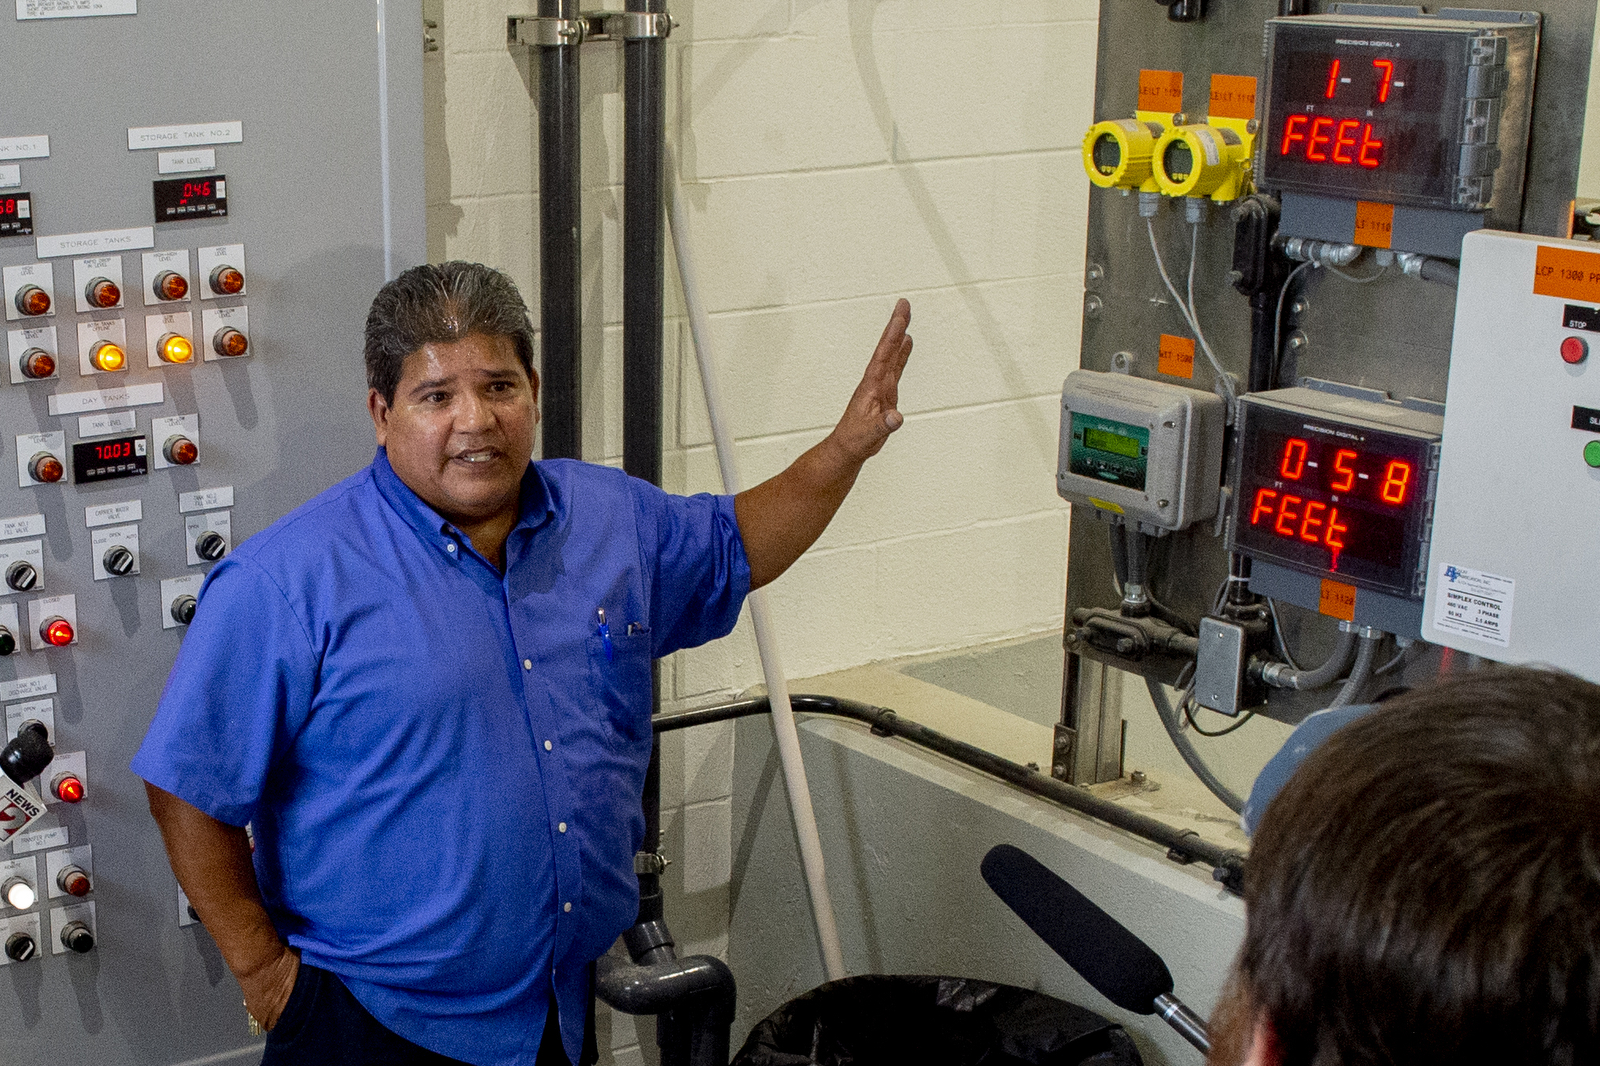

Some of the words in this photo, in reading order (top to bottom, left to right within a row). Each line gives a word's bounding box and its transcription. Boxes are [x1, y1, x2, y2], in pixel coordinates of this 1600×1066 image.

[1335, 39, 1368, 47] PRECISION
[1370, 40, 1394, 48] DIGITAL
[1306, 104, 1314, 112] FT
[140, 132, 178, 142] STORAGE
[184, 131, 205, 139] TANK
[60, 238, 99, 249] STORAGE
[104, 235, 132, 244] TANKS
[1535, 264, 1554, 277] LCP
[1569, 320, 1587, 329] STOP
[82, 397, 98, 405] DAY
[103, 393, 130, 402] TANKS
[107, 419, 122, 427] LEVEL
[1303, 423, 1335, 437] PRECISION
[1336, 430, 1360, 441] DIGITAL
[1274, 480, 1283, 489] FT
[1447, 592, 1472, 604] SIMPLEX
[1473, 599, 1501, 611] CONTROL
[1482, 610, 1499, 619] PHASE
[1484, 619, 1499, 628] AMPS
[6, 788, 40, 817] NEWS
